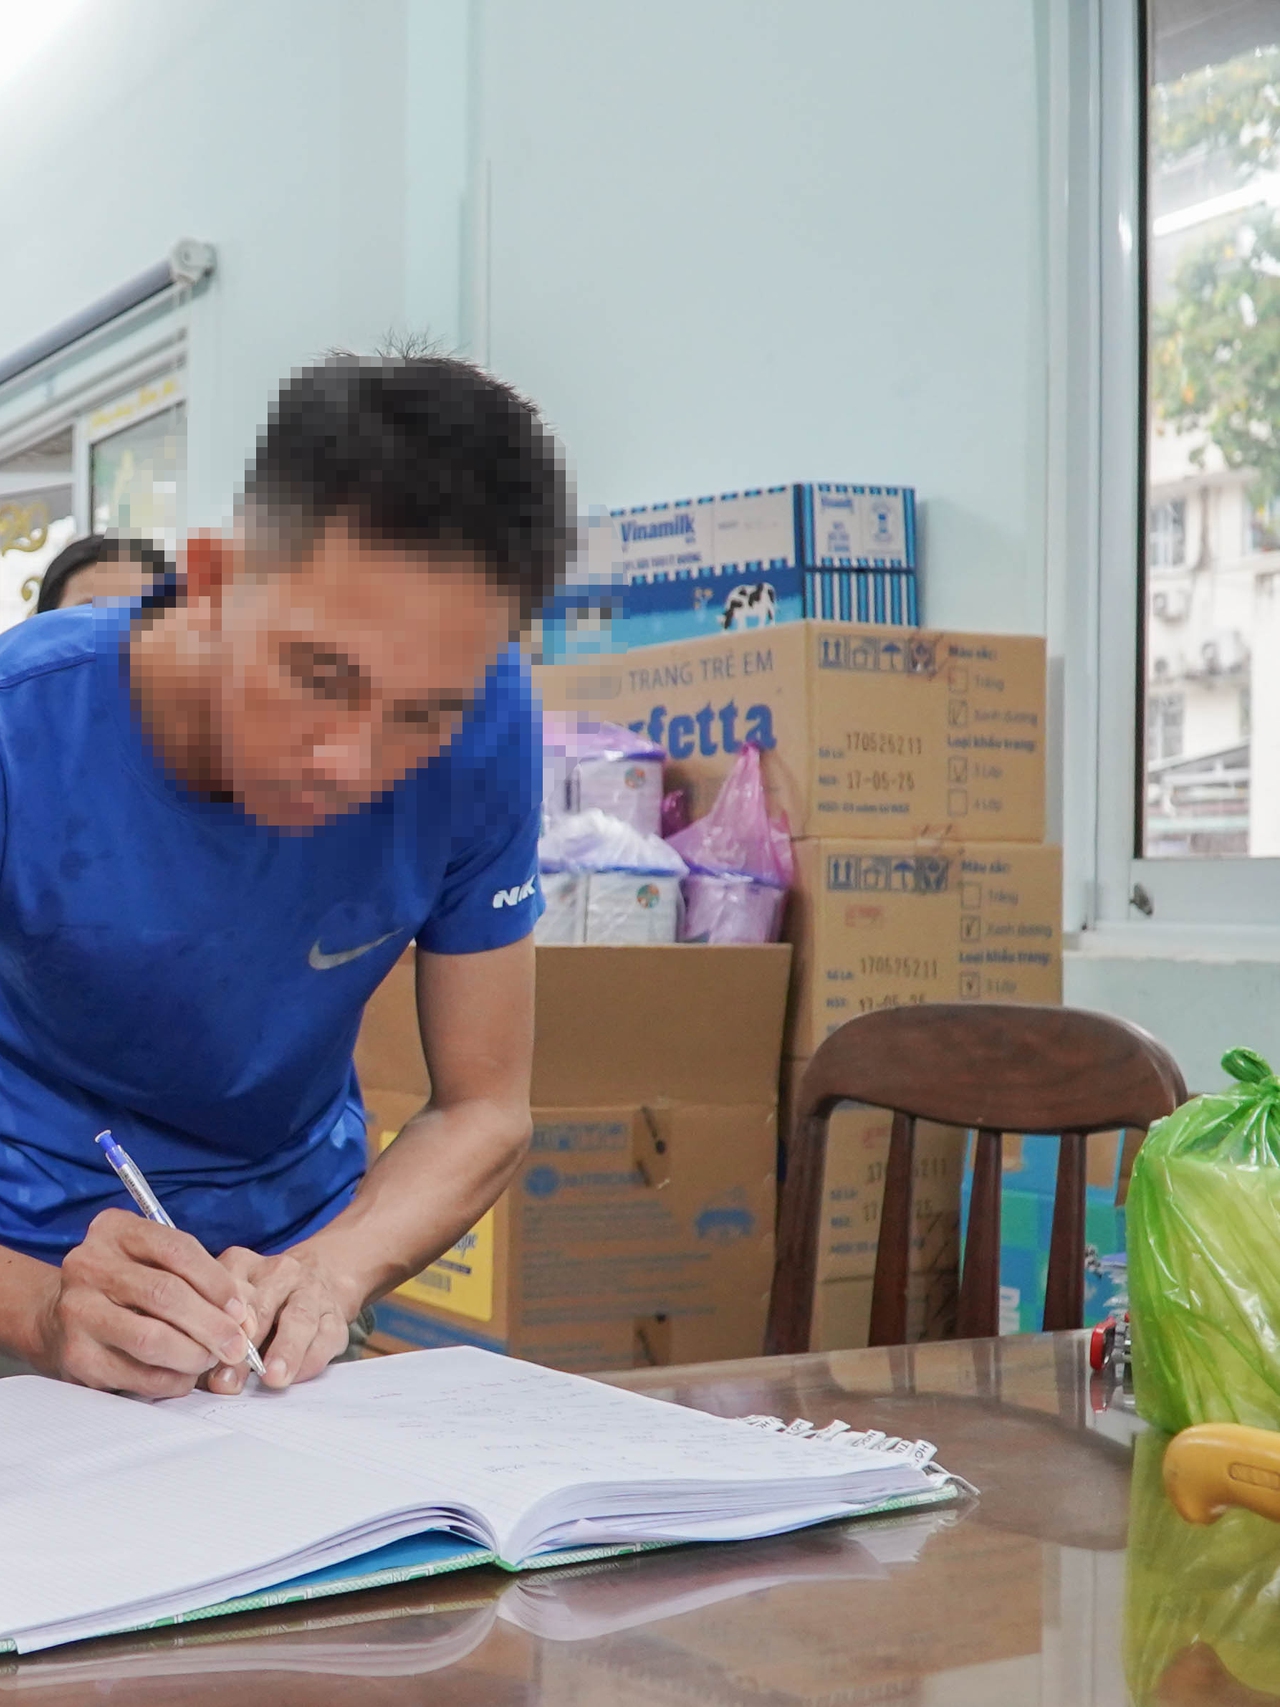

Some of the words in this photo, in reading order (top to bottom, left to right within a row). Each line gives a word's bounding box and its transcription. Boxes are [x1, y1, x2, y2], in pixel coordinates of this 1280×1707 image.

[621, 513, 695, 543] Vinamilk
[629, 662, 693, 694] TRANG
[743, 648, 774, 677] EM
